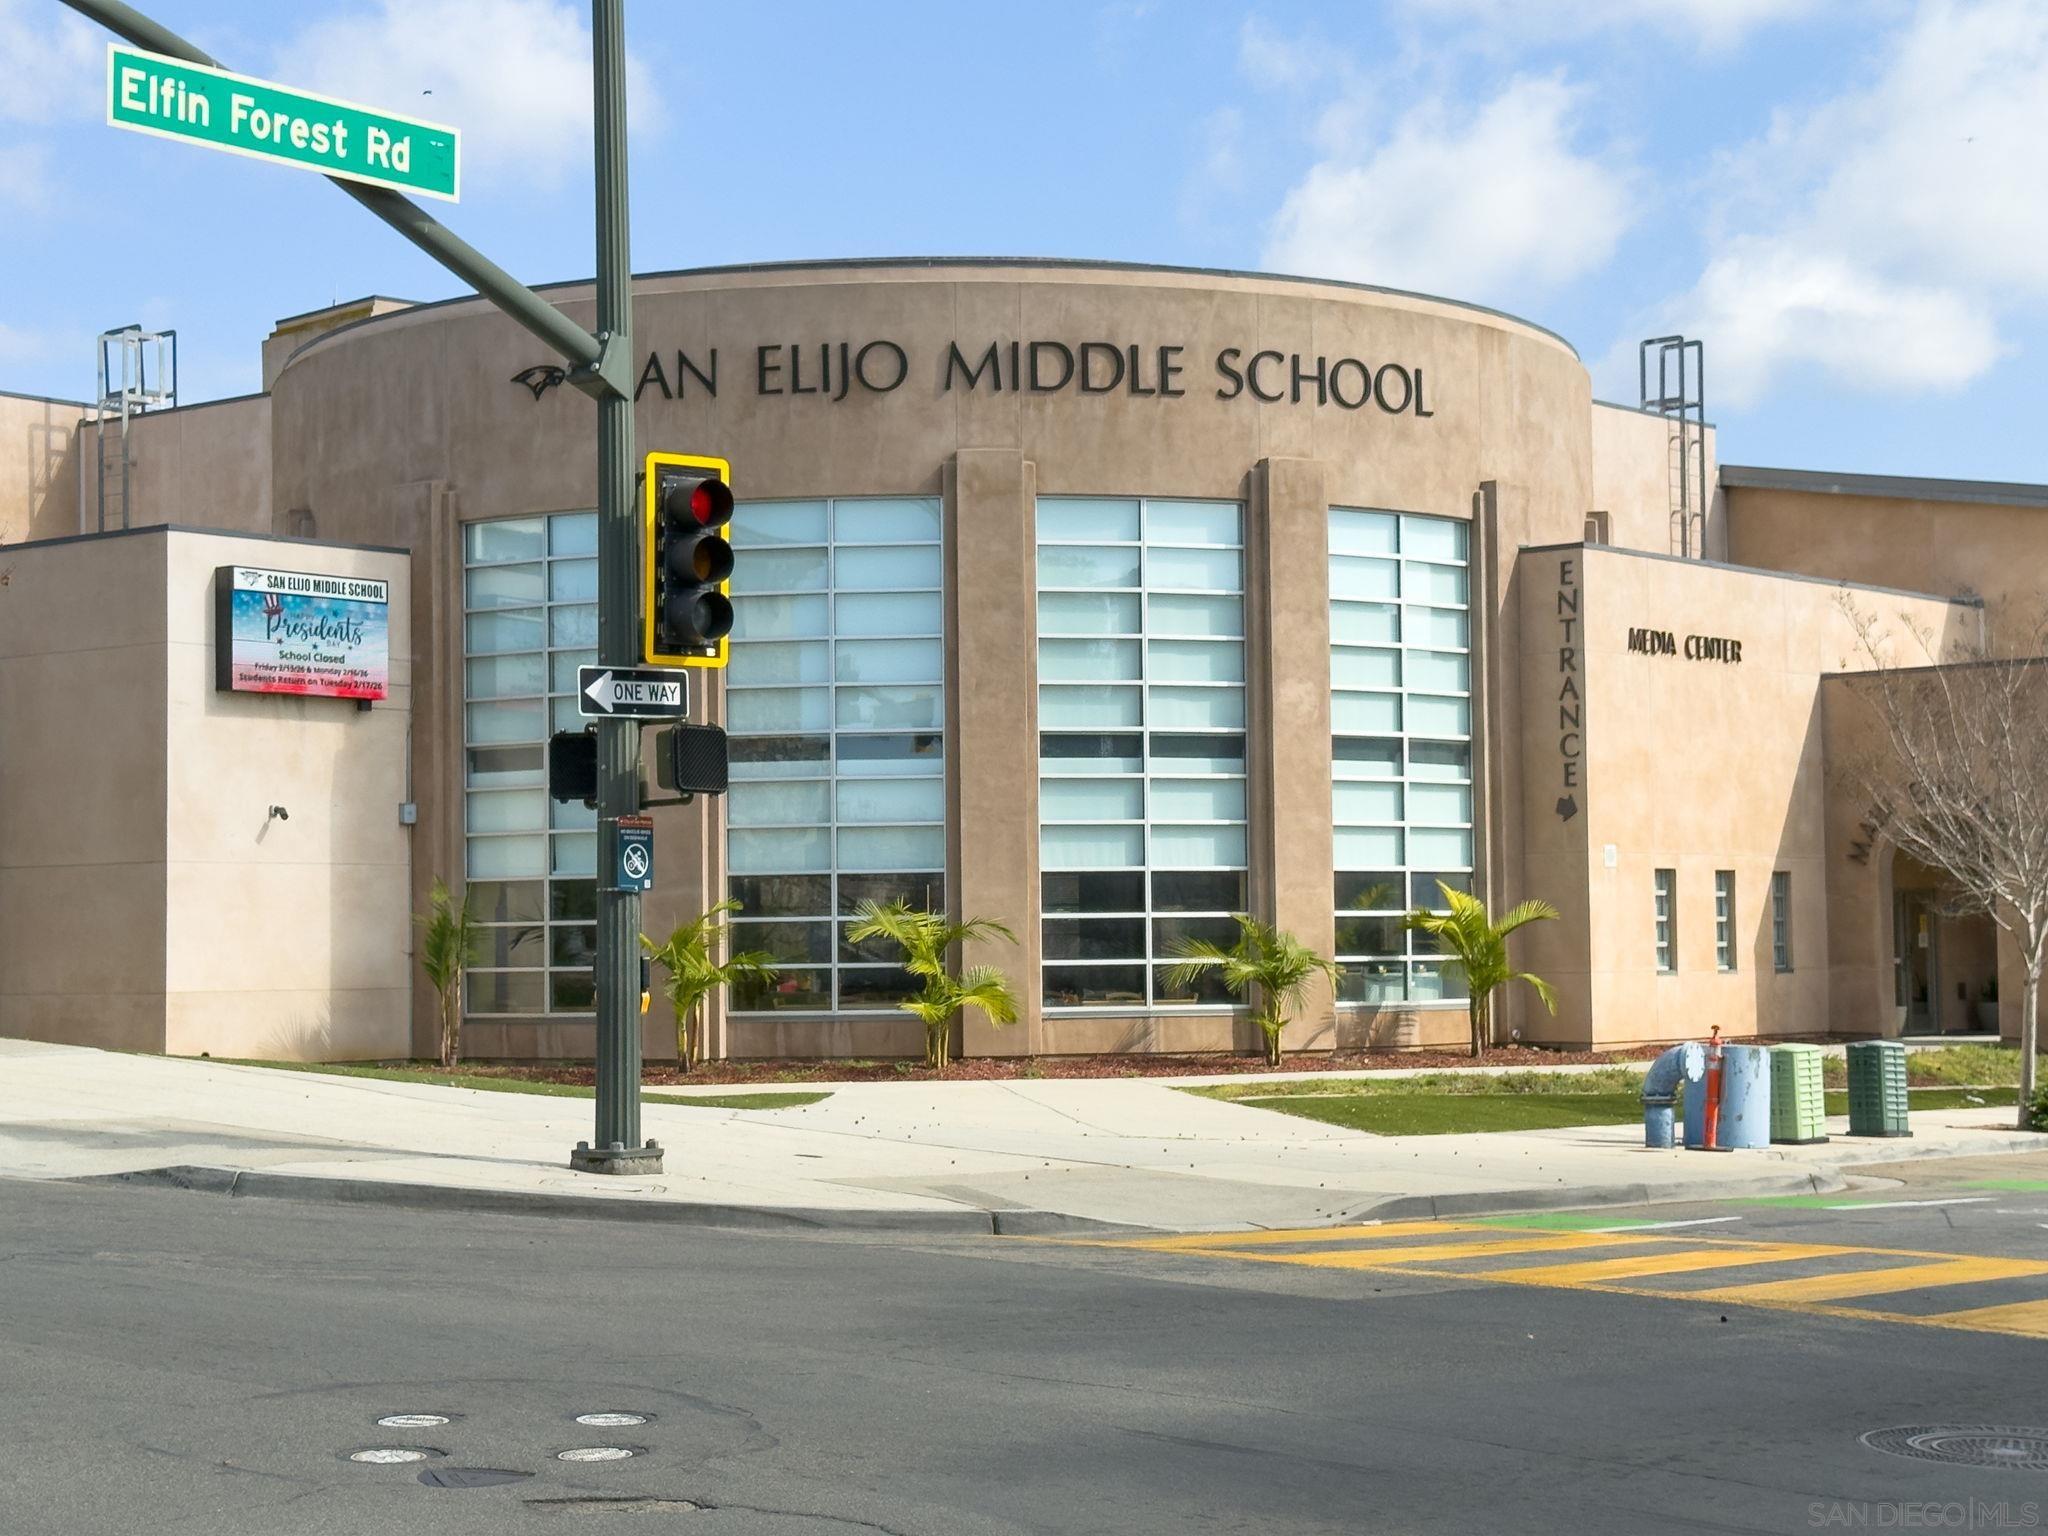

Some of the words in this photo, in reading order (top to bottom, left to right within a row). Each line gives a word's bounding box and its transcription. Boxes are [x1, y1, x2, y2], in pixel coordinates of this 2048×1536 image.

[121, 66, 209, 127] Elfin
[231, 93, 348, 158] Forest
[367, 126, 411, 173] Rd
[634, 348, 717, 400] AN
[757, 340, 908, 402] ELIJO
[945, 340, 1185, 397] MIDDLE
[1215, 347, 1434, 418] SCHOOL
[267, 575, 285, 589] SAN
[288, 577, 311, 592] ELIJO
[313, 579, 346, 596] MIDDLE
[348, 583, 384, 599] SCHOOL
[279, 650, 311, 662] School
[313, 653, 345, 664] Closed
[1628, 627, 1676, 656] MEDIA
[1684, 634, 1742, 663] CENTER
[239, 673, 276, 683] Students
[278, 676, 305, 685] Return
[320, 678, 352, 690] Tuesday
[1557, 560, 1580, 787] ENTRANCE
[614, 684, 642, 701] ONE
[648, 684, 678, 702] WAY
